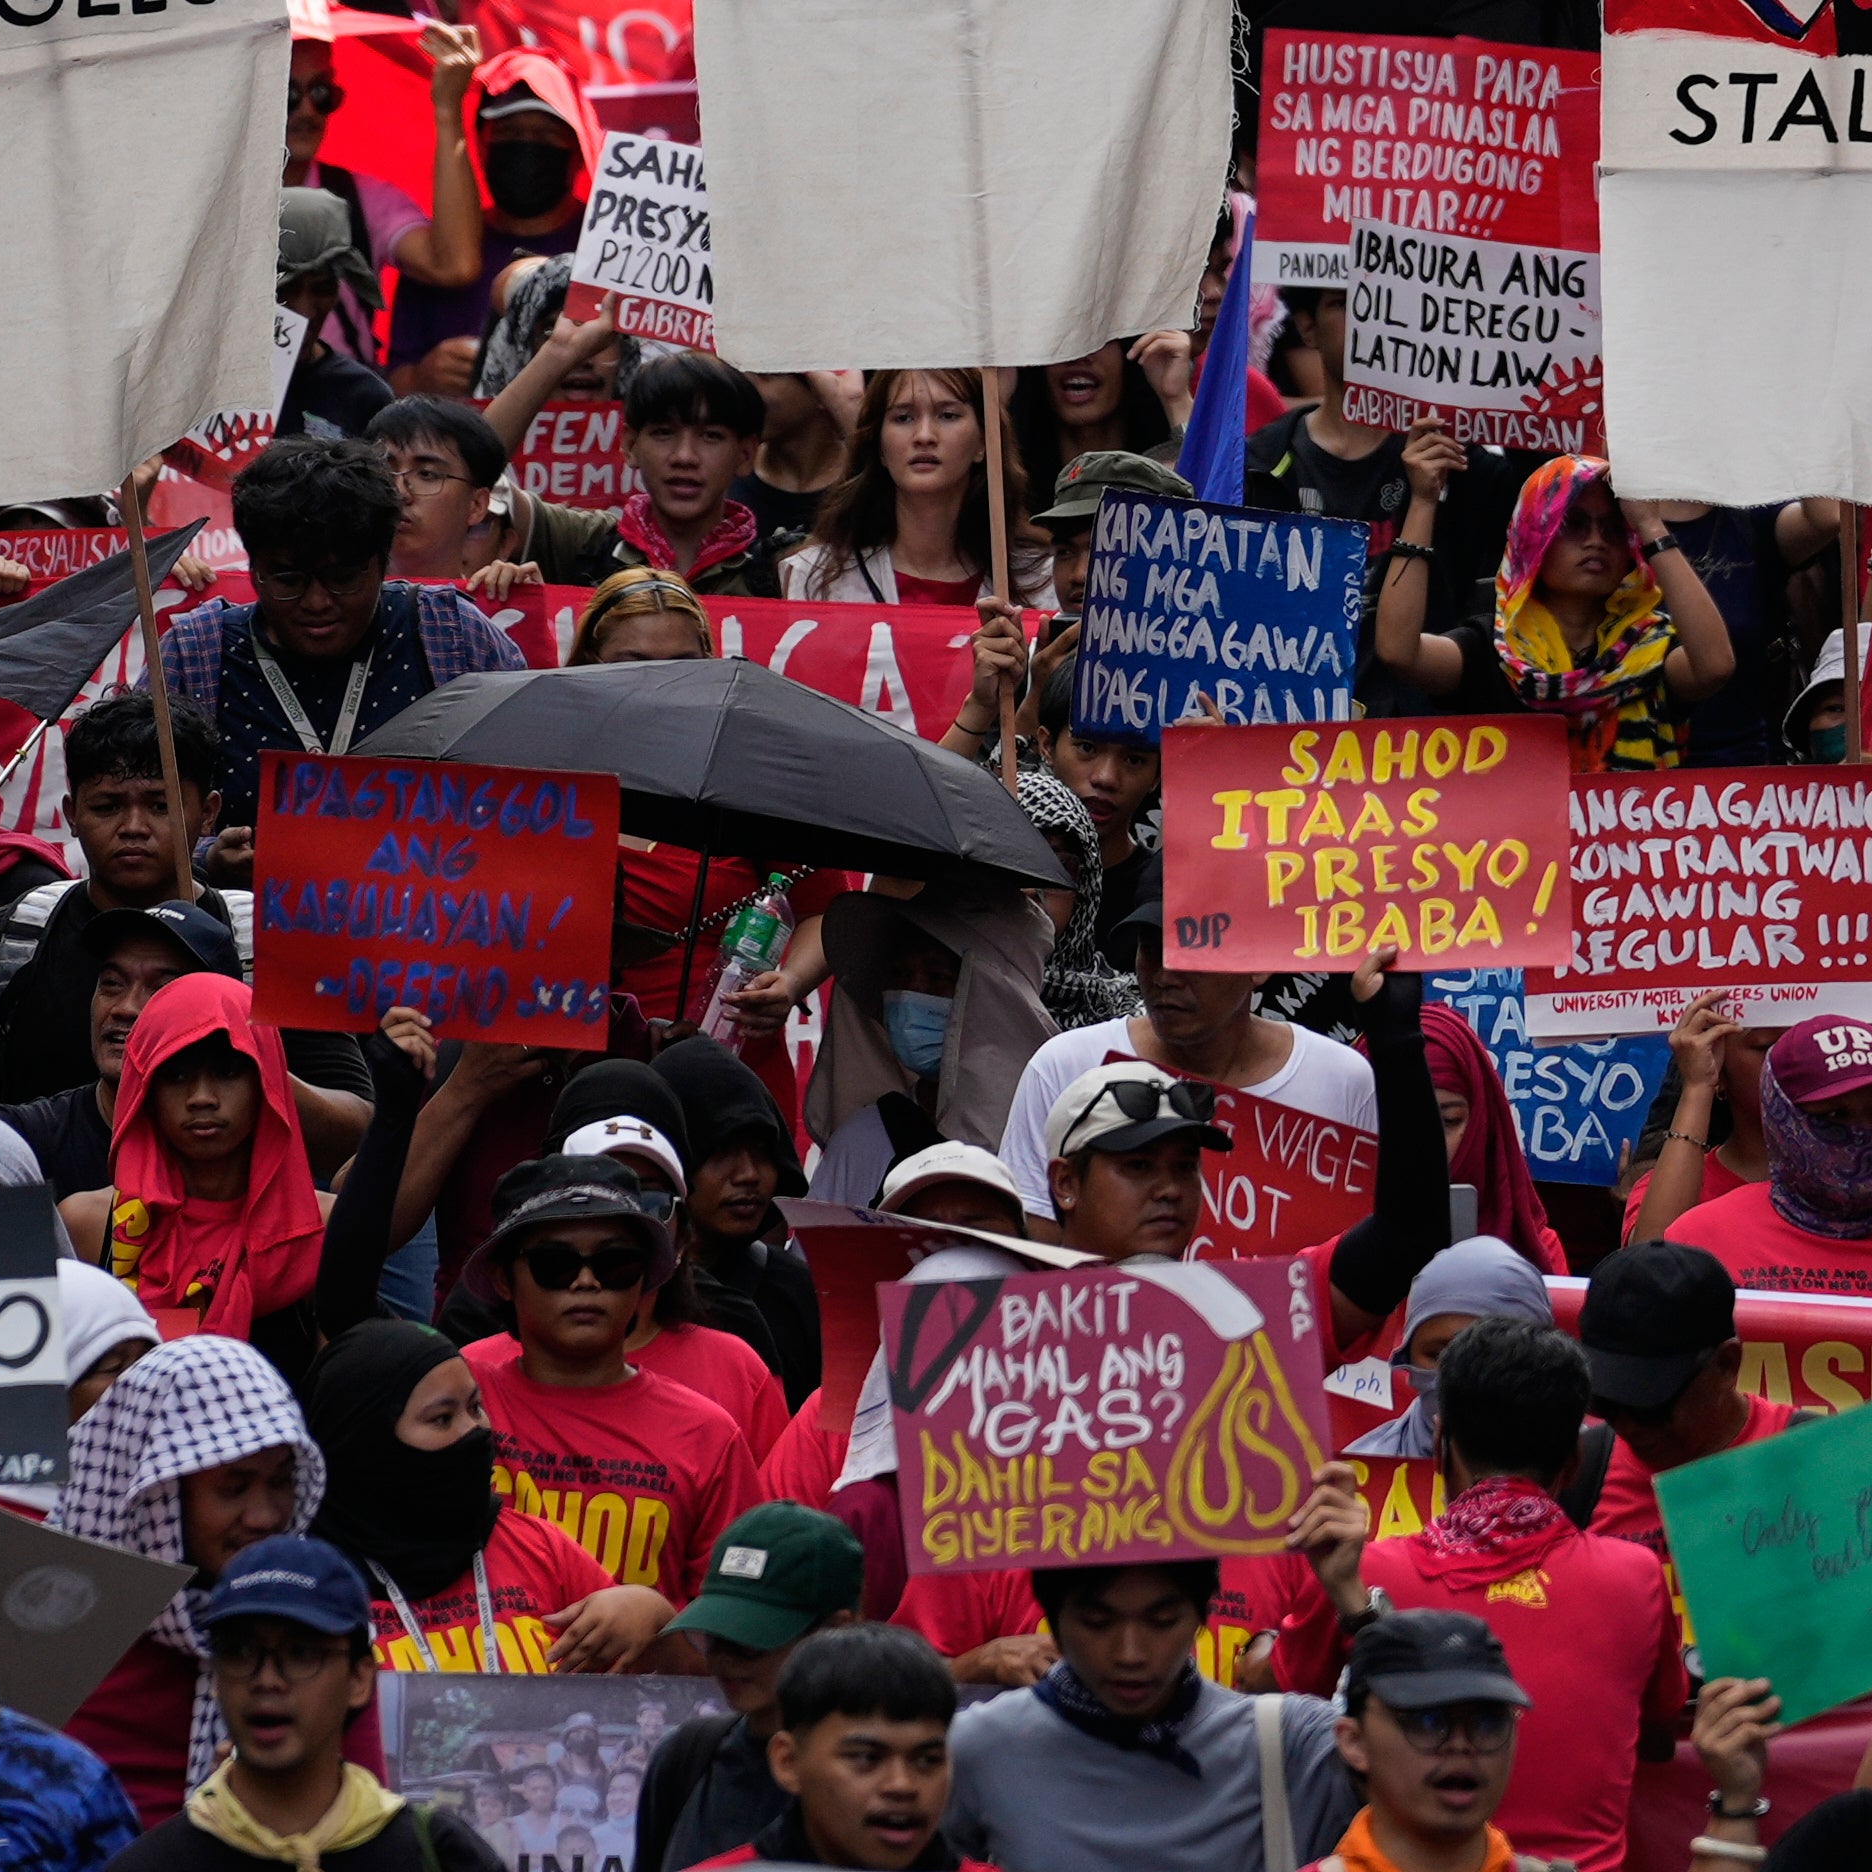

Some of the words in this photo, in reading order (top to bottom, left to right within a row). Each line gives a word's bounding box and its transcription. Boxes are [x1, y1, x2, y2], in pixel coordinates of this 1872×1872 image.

[1282, 43, 1458, 96] HUSTISYA
[1474, 55, 1561, 112] PARA
[1270, 94, 1315, 131] SA
[1322, 94, 1396, 133] MGA
[604, 140, 706, 192] SAH
[1294, 136, 1340, 176] NG
[1351, 140, 1542, 195] BERDUGONG
[593, 239, 690, 297] P1200
[1354, 228, 1484, 292] IBASURA
[1500, 251, 1588, 298] ANG
[618, 297, 717, 352] GABRIE
[1351, 280, 1407, 326] OIL
[1351, 330, 1463, 386] LATION
[1470, 351, 1553, 389] LAW
[1096, 502, 1323, 592] KARAPATAN
[1091, 558, 1127, 601] NG
[1143, 563, 1225, 619] MGA
[1085, 605, 1343, 678] MANGGAGAWA
[1282, 725, 1509, 788] SAHOD
[273, 760, 595, 839] IPAGTANGGOL
[1211, 787, 1441, 849] ITAAS
[365, 831, 479, 882] ANG
[1266, 837, 1530, 908] PRESYO
[1581, 878, 1802, 927] GAWING
[1564, 923, 1805, 979] REGULAR
[1552, 989, 1638, 1014] UNIVERSITY
[1642, 989, 1684, 1007] HOTEL
[1770, 986, 1818, 1002] UNION
[1254, 1104, 1378, 1194] WAGE
[924, 1343, 1089, 1439] MAHAL
[1097, 1332, 1185, 1402] ANG
[983, 1387, 1185, 1458] GAS?
[920, 1430, 1072, 1516] DAHIL
[1081, 1446, 1161, 1500] SA
[921, 1493, 1174, 1566] GIYERANG
